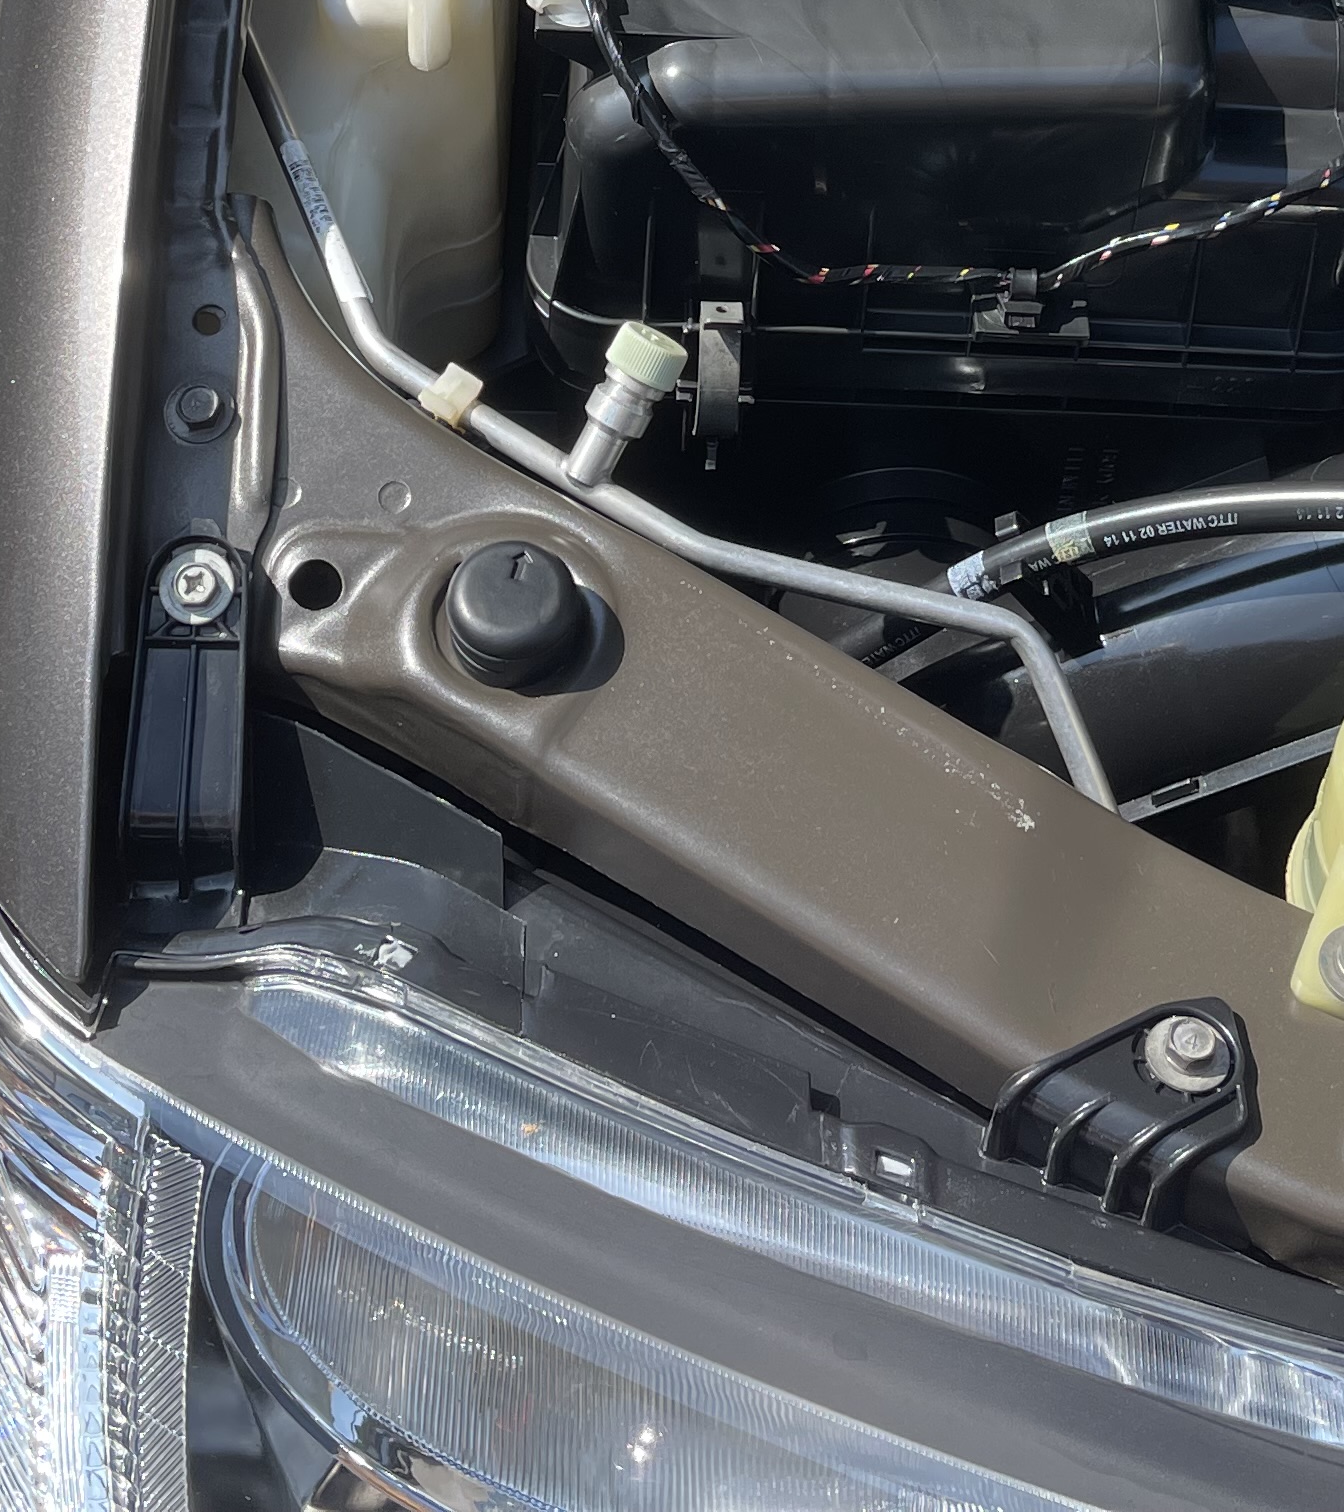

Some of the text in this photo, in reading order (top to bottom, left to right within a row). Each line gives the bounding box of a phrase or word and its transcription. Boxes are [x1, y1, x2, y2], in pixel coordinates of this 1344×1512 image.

[1156, 517, 1207, 536] WATER
[1103, 534, 1120, 548] 14
[1121, 531, 1138, 542] 11
[1138, 528, 1156, 540] 02
[861, 642, 896, 666] WATE
